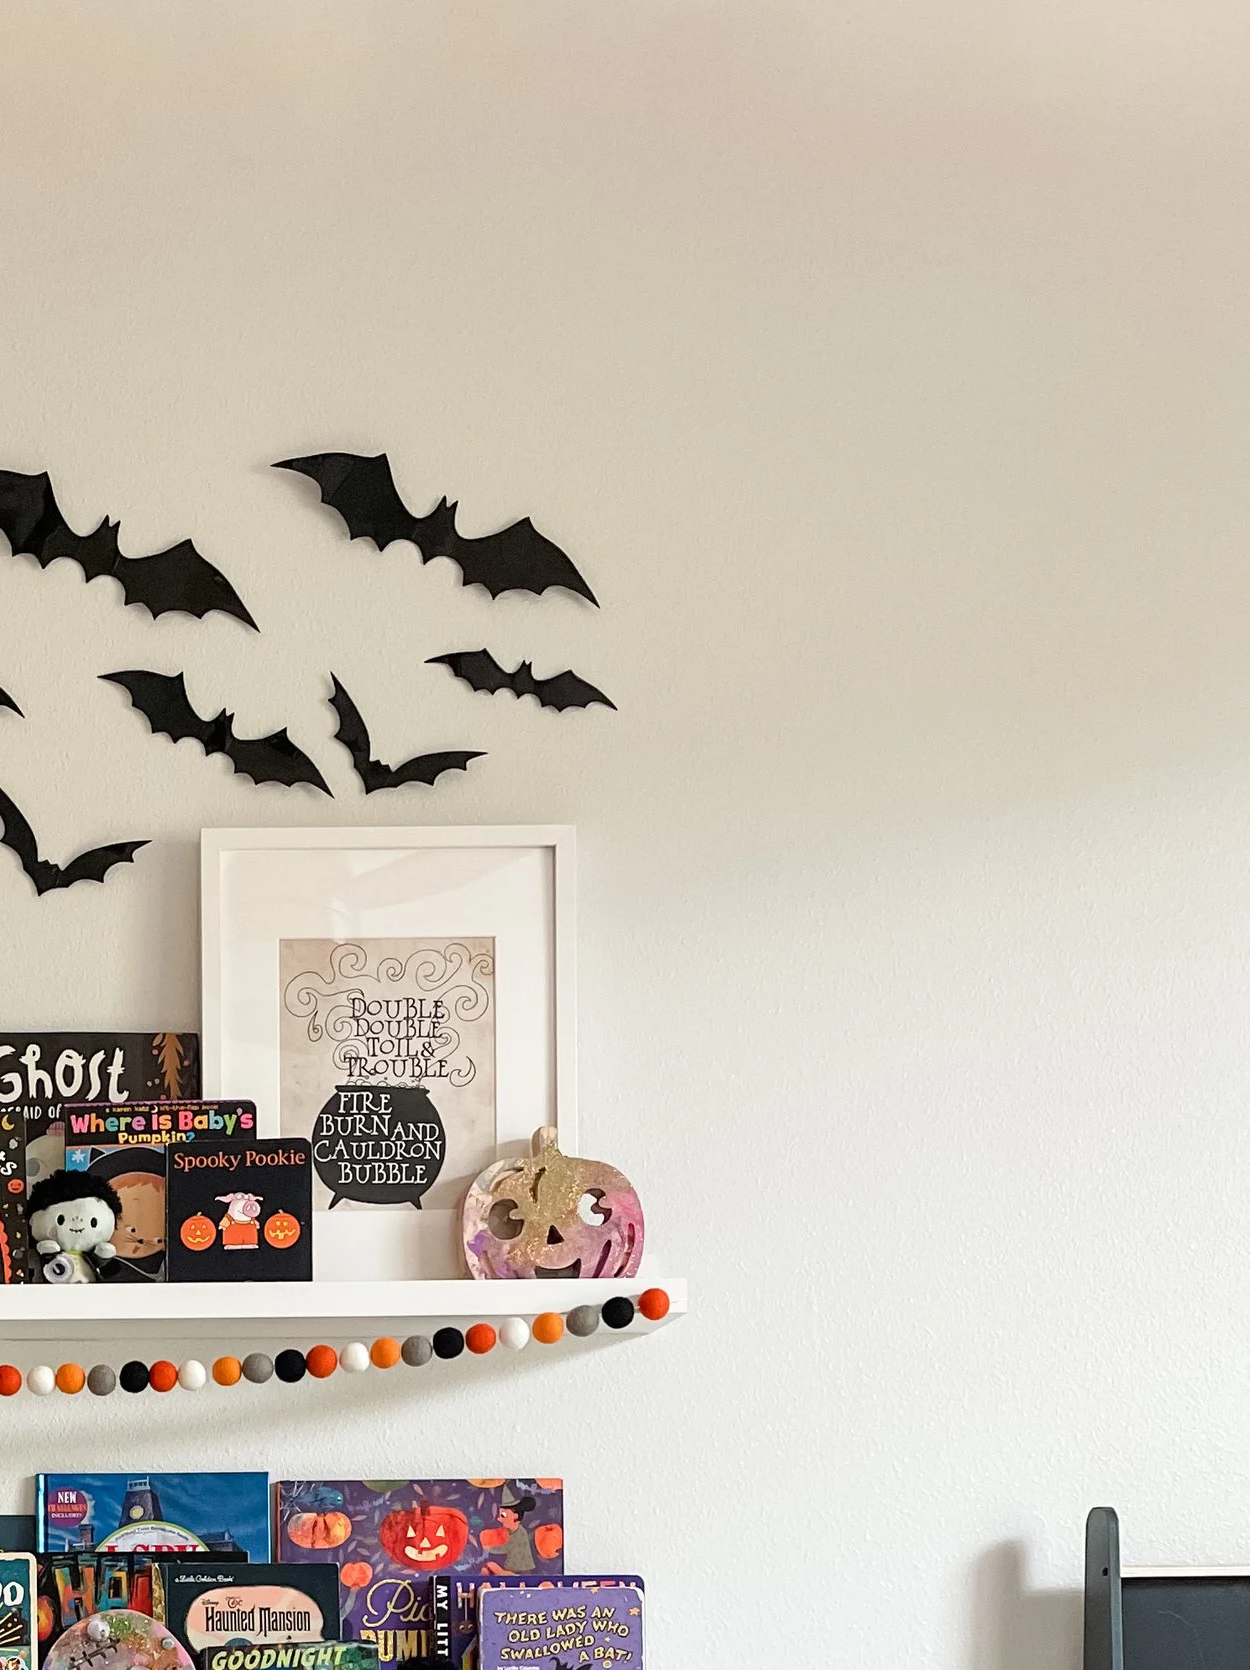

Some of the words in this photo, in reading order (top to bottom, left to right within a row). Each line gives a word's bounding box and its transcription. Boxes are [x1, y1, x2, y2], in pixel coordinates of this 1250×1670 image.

[349, 996, 446, 1019] DOUBLE
[353, 1017, 443, 1038] DOUBLE
[365, 1036, 420, 1058] TOIL
[421, 1041, 436, 1058] &
[343, 1056, 450, 1078] TROUBLE
[338, 1091, 393, 1114] FIRE
[70, 1113, 146, 1134] Where
[178, 1107, 254, 1136] Baby's
[319, 1114, 391, 1136] BURN
[390, 1121, 440, 1141] AND
[118, 1131, 195, 1144] Pumpkin?
[173, 1151, 241, 1173] Spooky
[245, 1149, 306, 1167] Pookie
[313, 1141, 443, 1162] CAULDRON
[337, 1162, 428, 1185] BUBBLE
[57, 1491, 77, 1504] NEW
[362, 1578, 431, 1628] Pic
[436, 1584, 448, 1611] MY
[205, 1605, 255, 1632] Haunted
[256, 1606, 311, 1637] Mansion
[495, 1611, 548, 1626] THERE
[551, 1605, 587, 1622] WAS
[591, 1606, 617, 1619] AN
[436, 1622, 448, 1657] LITT
[508, 1628, 541, 1643] OLD
[545, 1620, 588, 1640] LADY
[591, 1620, 630, 1638] WHO
[500, 1635, 595, 1661] SWALLOWED
[578, 1650, 591, 1664] A
[594, 1647, 632, 1662] BAT!
